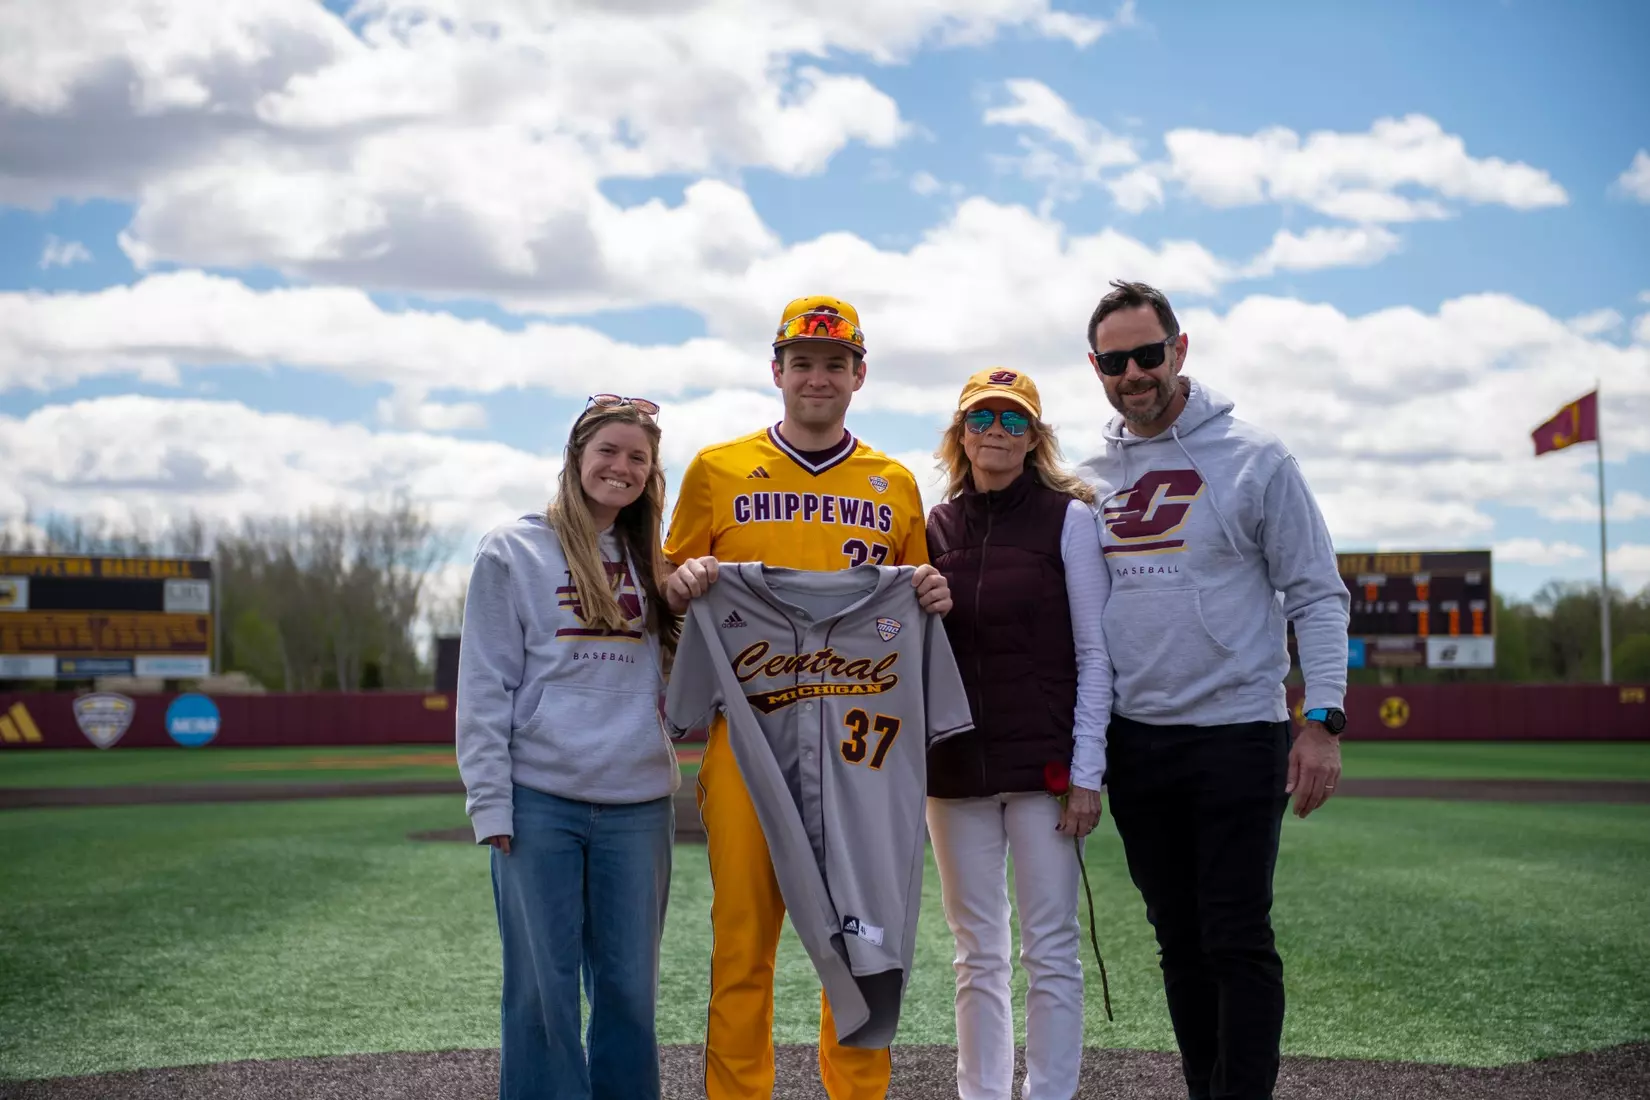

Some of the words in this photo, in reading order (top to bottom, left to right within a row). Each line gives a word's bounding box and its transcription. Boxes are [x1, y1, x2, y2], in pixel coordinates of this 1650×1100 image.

[733, 491, 893, 534] CHIPPEWAS
[878, 623, 899, 634] MAC
[573, 652, 635, 663] BASEBALL
[731, 640, 898, 684] Central
[768, 684, 882, 704] MICHIGAN
[840, 707, 901, 771] 37
